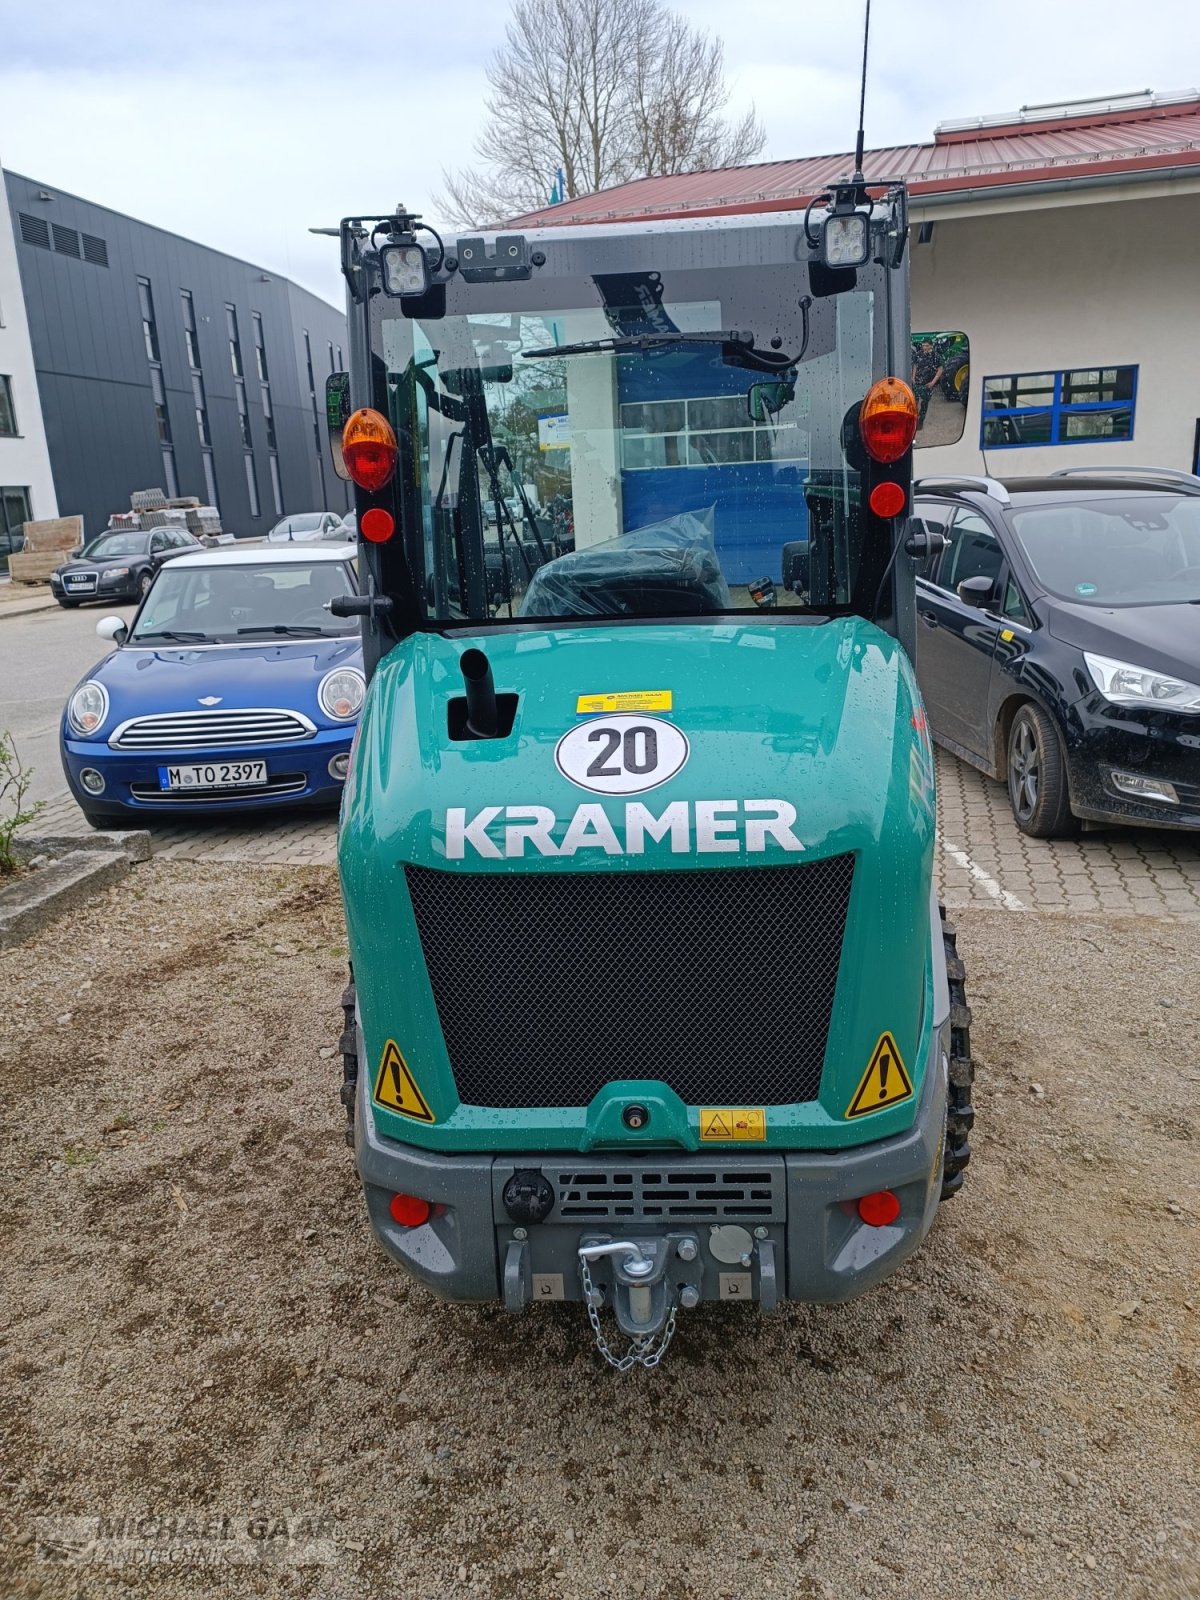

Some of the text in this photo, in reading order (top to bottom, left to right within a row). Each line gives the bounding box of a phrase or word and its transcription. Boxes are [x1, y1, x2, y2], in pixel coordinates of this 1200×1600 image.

[168, 768, 182, 784] M
[192, 767, 215, 784] TO
[220, 763, 264, 782] 2397
[586, 725, 658, 777] 20
[445, 799, 806, 859] KRAMER
